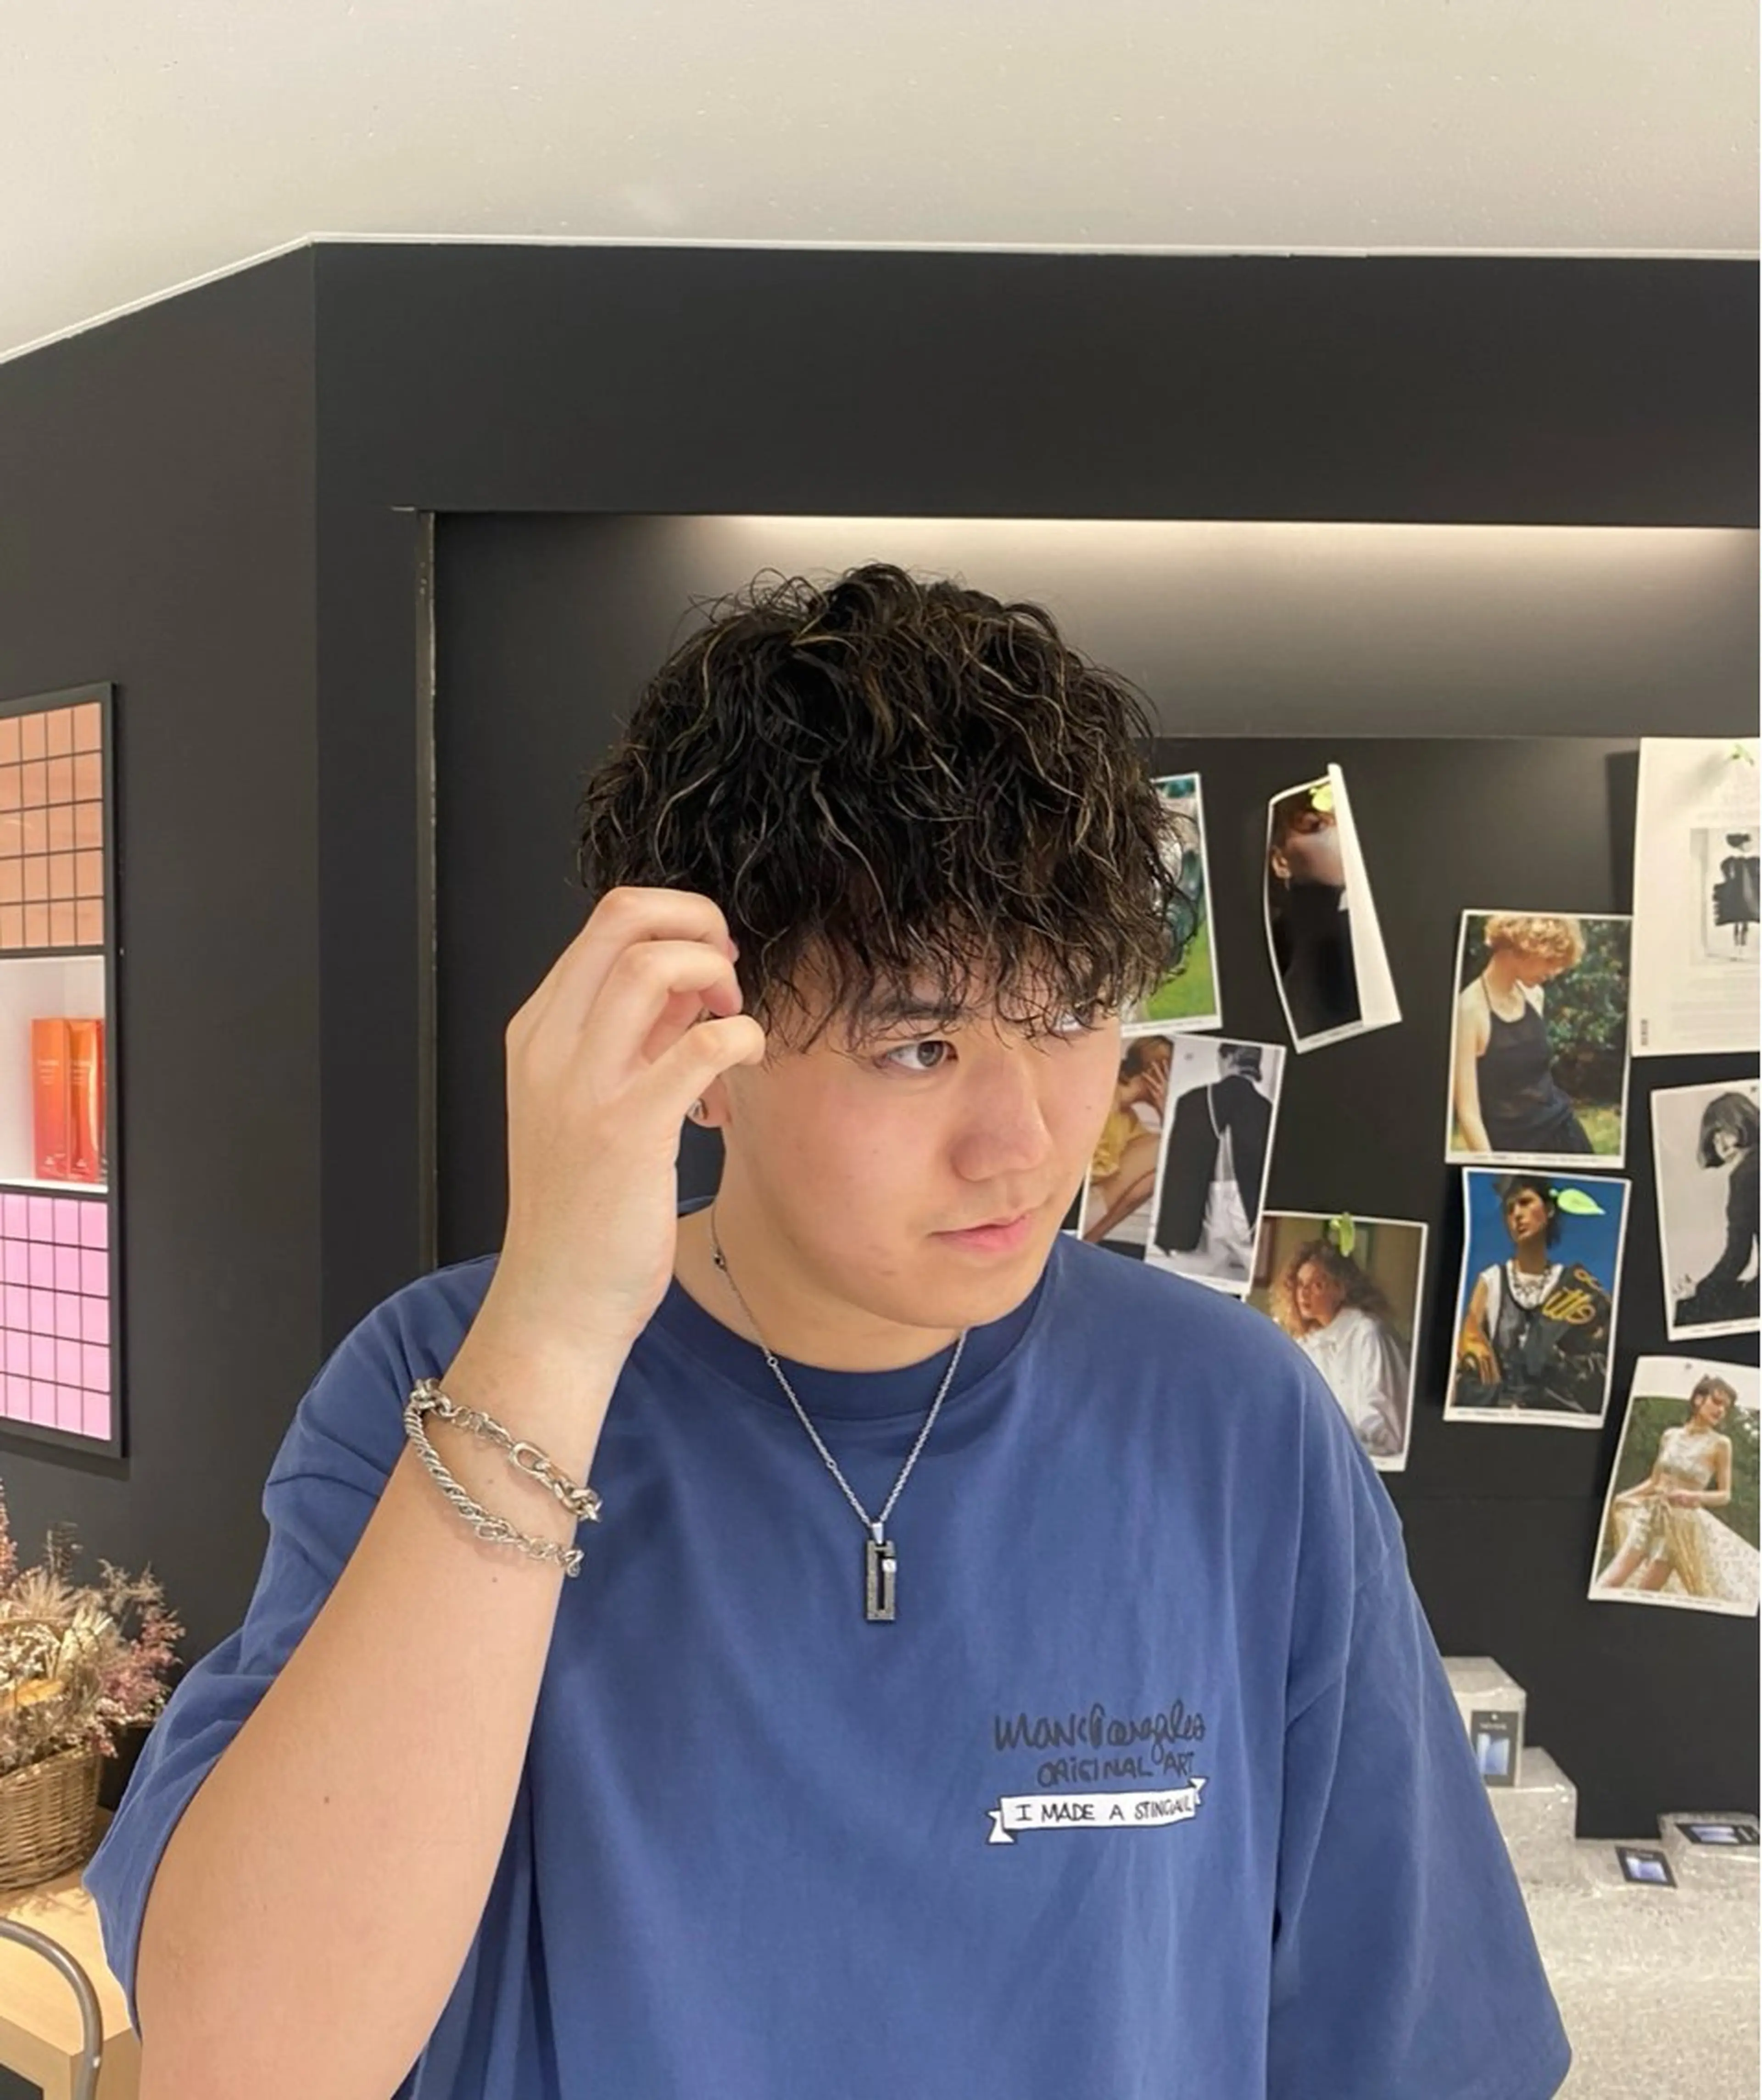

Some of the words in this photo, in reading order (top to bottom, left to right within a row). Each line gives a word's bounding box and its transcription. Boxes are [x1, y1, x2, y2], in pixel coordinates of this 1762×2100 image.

[1163, 1750, 1195, 1778] ART
[1015, 1803, 1032, 1821] I
[1041, 1802, 1095, 1822] MADE
[1109, 1804, 1126, 1821] A
